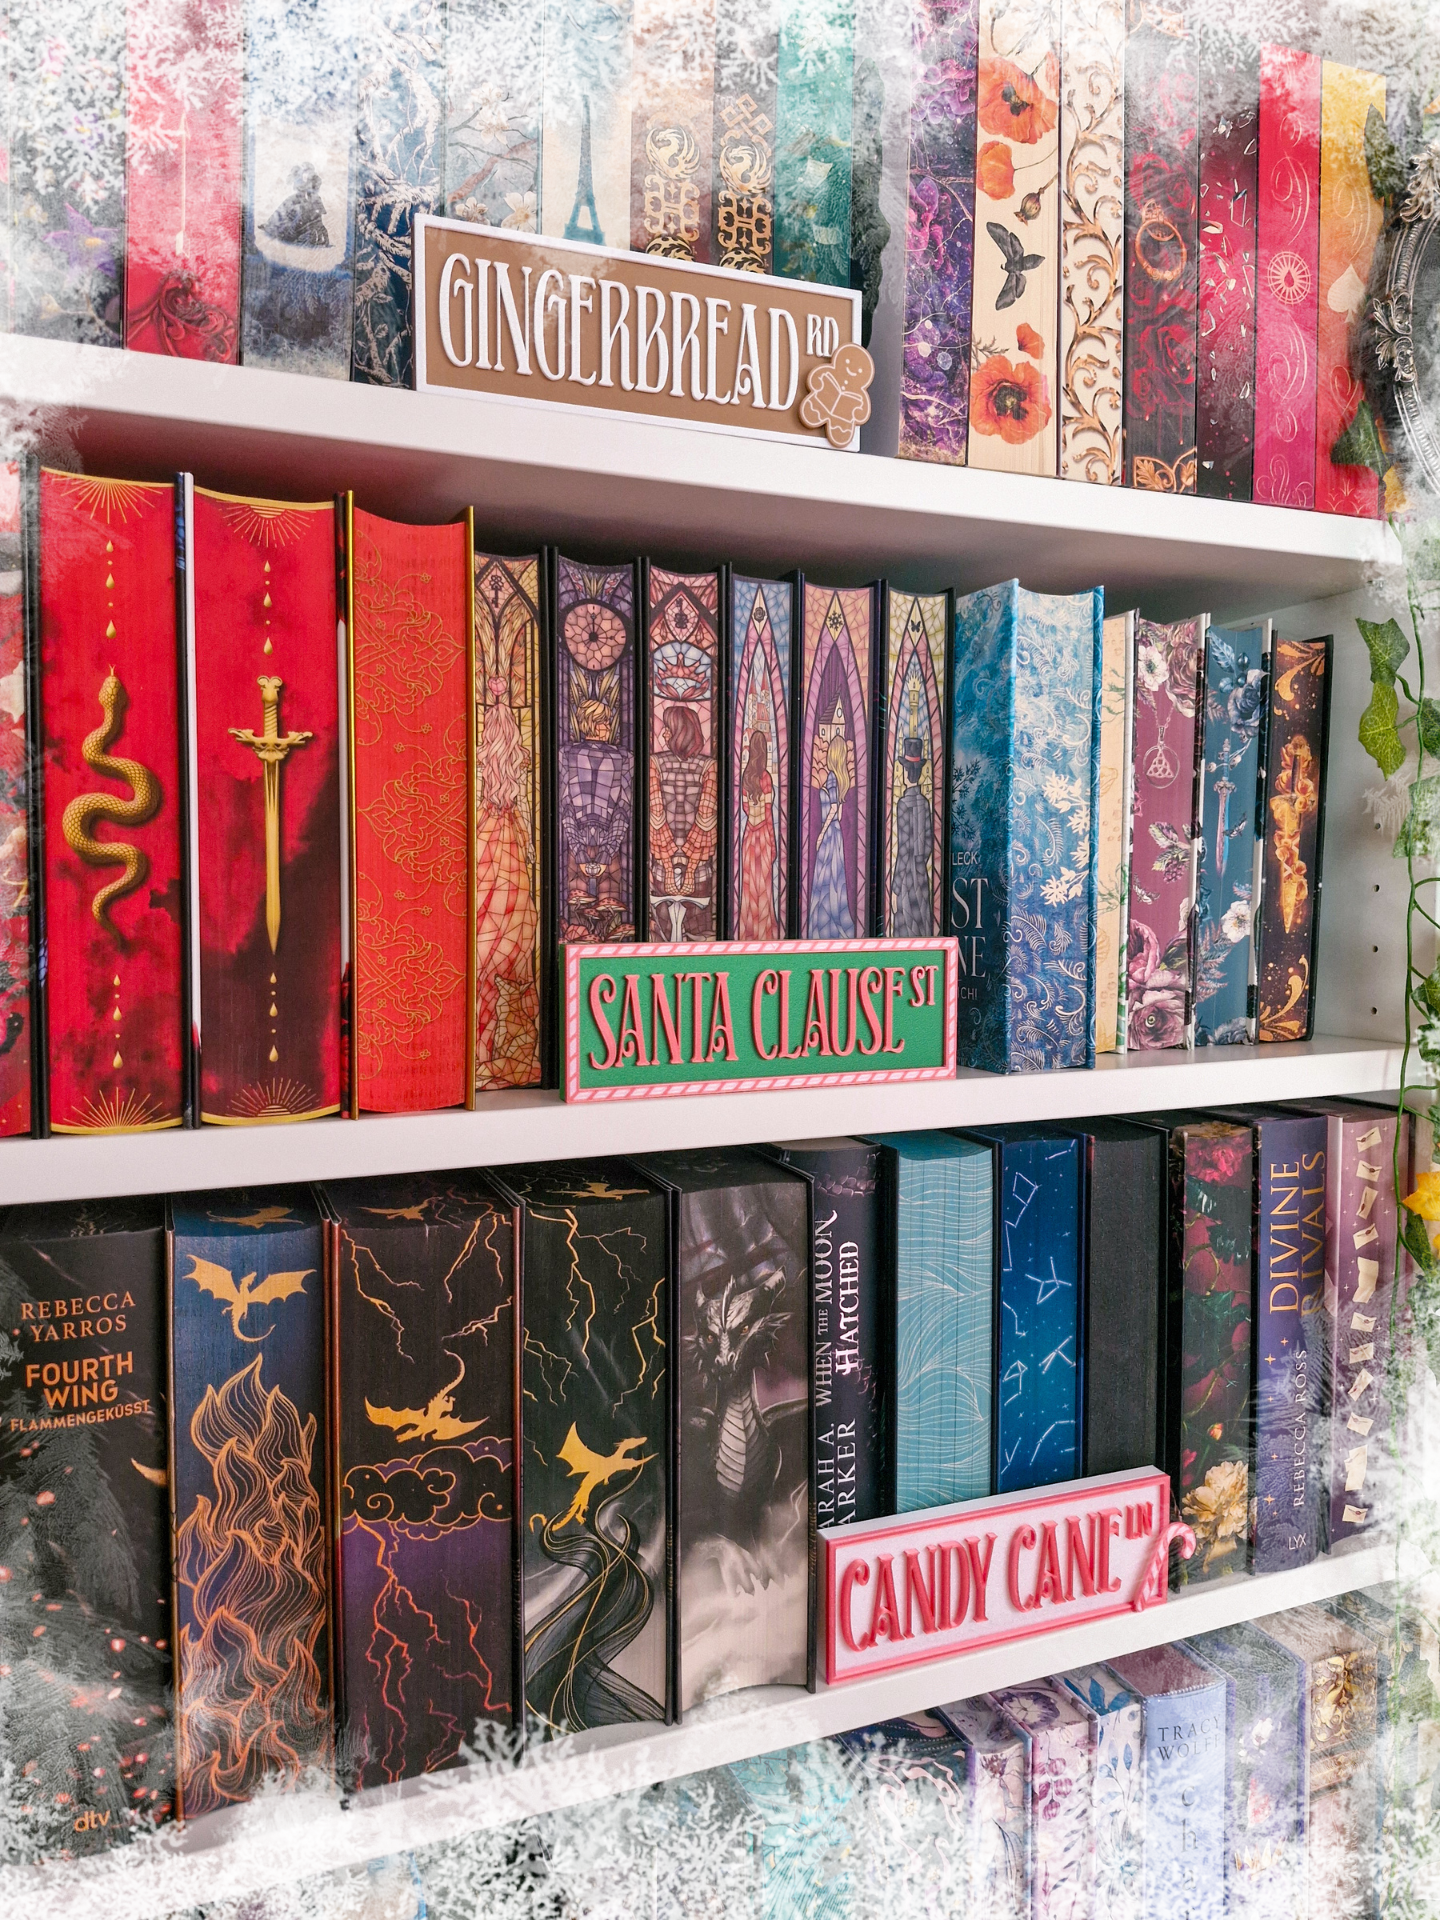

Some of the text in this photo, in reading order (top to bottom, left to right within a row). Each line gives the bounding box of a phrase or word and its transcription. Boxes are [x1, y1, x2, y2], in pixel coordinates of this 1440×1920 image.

[439, 253, 840, 411] GINGERBREAD RD
[589, 965, 939, 1070] SANTA CLAUSE ST
[1269, 1161, 1299, 1314] DIVINE
[1301, 1150, 1325, 1317] RIVALS
[21, 1291, 136, 1320] REBECCA
[815, 1209, 838, 1407] WHEN THE MOON
[834, 1240, 859, 1376] HATCHED
[30, 1314, 127, 1342] YARROS
[25, 1351, 133, 1388] FOURTH
[43, 1379, 118, 1409] WING
[10, 1399, 150, 1433] FLAMMENGEKÜSST
[818, 1423, 834, 1446] A.
[1293, 1350, 1307, 1507] REBECCA ROSS
[1288, 1533, 1307, 1550] LYX
[840, 1532, 998, 1653] CANDY
[1008, 1507, 1122, 1613] CANE
[1125, 1501, 1154, 1540] LN
[1157, 1714, 1221, 1742] TRACY
[74, 1809, 110, 1833] dtv
